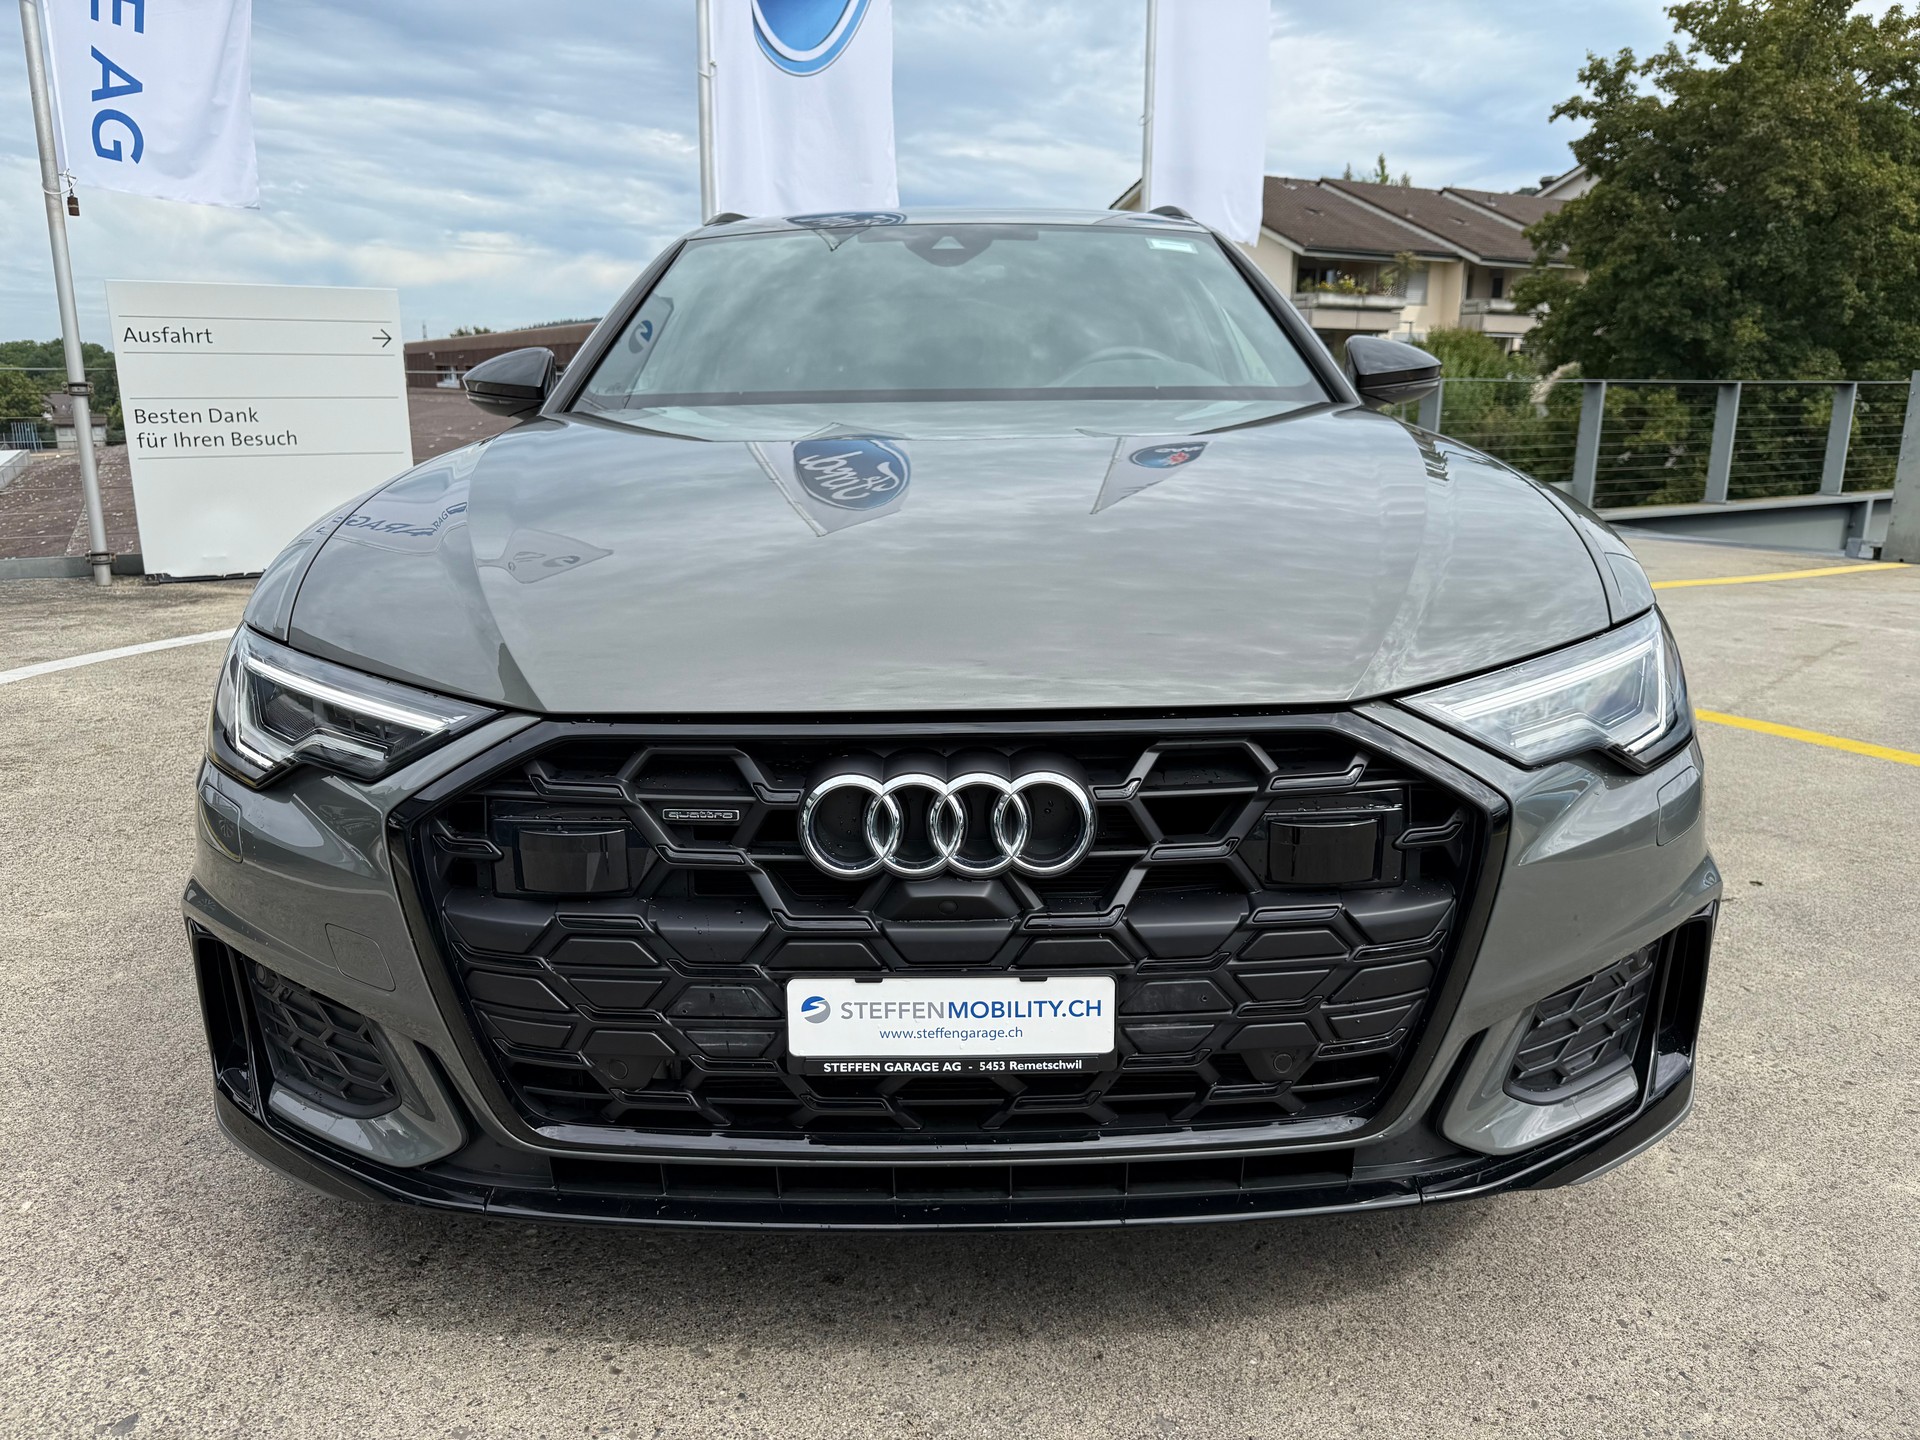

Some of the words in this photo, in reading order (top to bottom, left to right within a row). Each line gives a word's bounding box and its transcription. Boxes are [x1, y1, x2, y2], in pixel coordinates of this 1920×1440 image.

[91, 45, 144, 164] AG
[123, 326, 214, 344] Ausfahrt
[134, 408, 202, 424] Besten
[208, 406, 260, 424] Dank
[136, 431, 168, 449] für
[173, 431, 225, 448] Ihren
[231, 429, 298, 447] Besuch
[668, 811, 733, 819] quattro
[840, 999, 1102, 1020] STEFFENMOBILITY.CH
[879, 1026, 1023, 1042] www.steffengarage.ch
[823, 1062, 881, 1073] STEFFEN
[883, 1062, 940, 1072] GARAGE
[942, 1061, 962, 1072] AG
[979, 1060, 1006, 1071] 5453
[1009, 1059, 1083, 1071] Remetschwil
